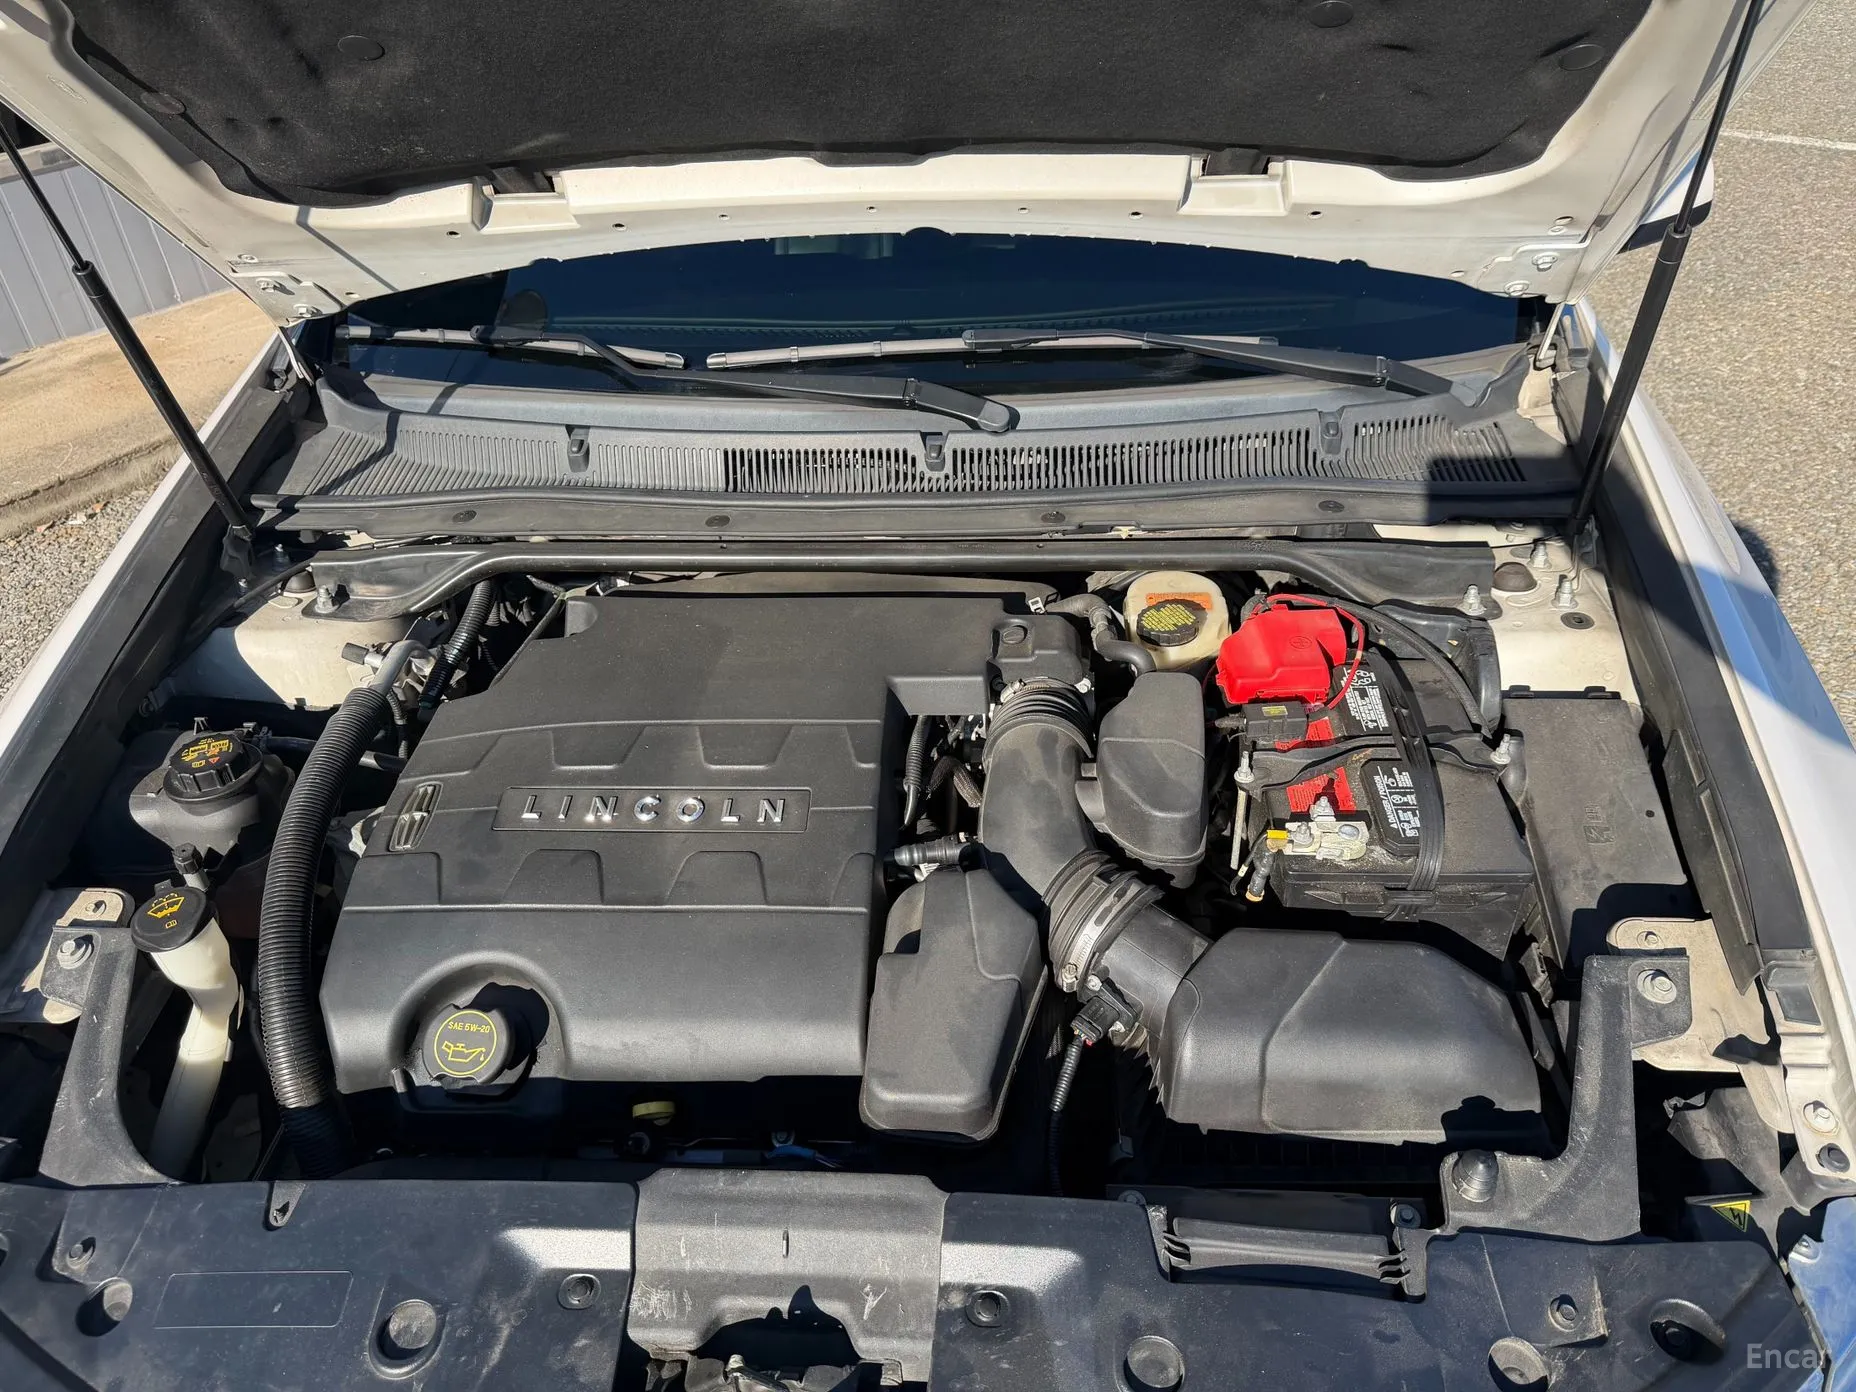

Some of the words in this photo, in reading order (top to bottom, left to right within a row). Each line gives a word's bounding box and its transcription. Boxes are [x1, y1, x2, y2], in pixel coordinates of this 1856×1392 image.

[521, 795, 785, 822] LINCOLN
[448, 1021, 464, 1031] SAE
[464, 1023, 490, 1033] 5W-20
